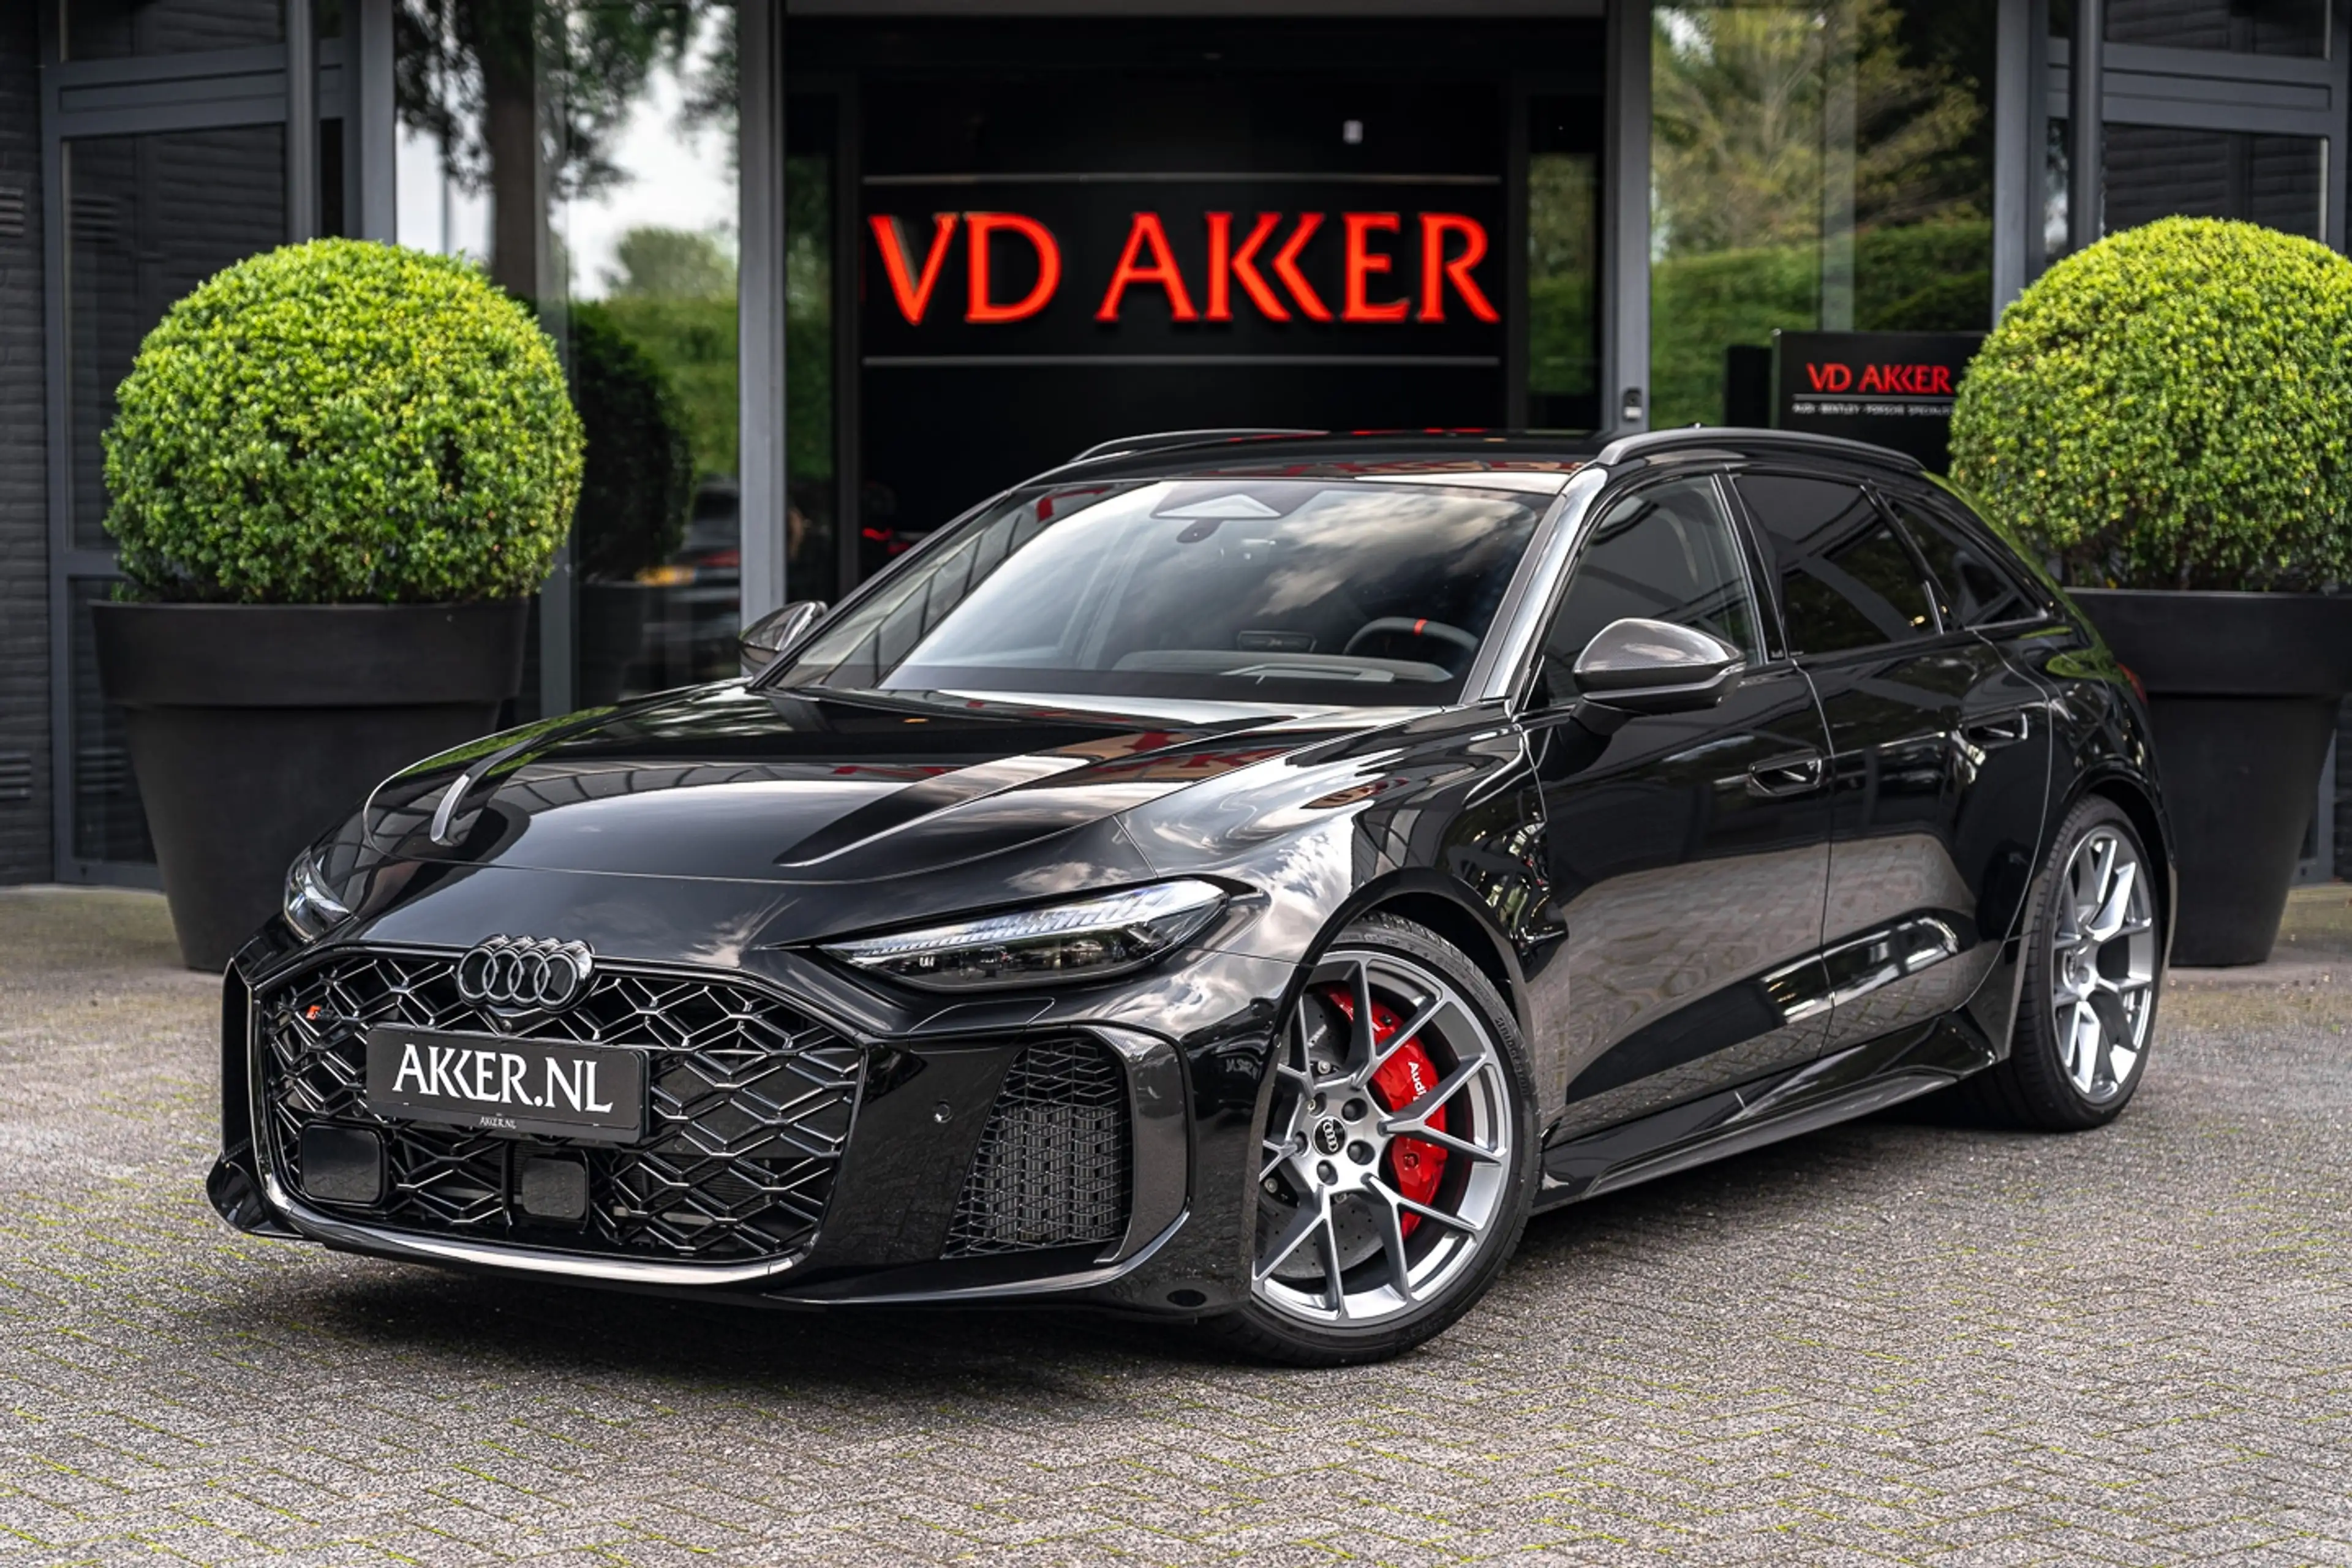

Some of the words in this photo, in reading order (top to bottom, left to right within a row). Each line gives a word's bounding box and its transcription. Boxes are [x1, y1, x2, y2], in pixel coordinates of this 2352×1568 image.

[868, 211, 1061, 326] VD
[1095, 211, 1501, 324] AKKER
[1806, 363, 1852, 393] VD
[1857, 364, 1954, 394] AKKER
[391, 1043, 613, 1114] AKKER.NL
[1408, 1061, 1427, 1096] Audi
